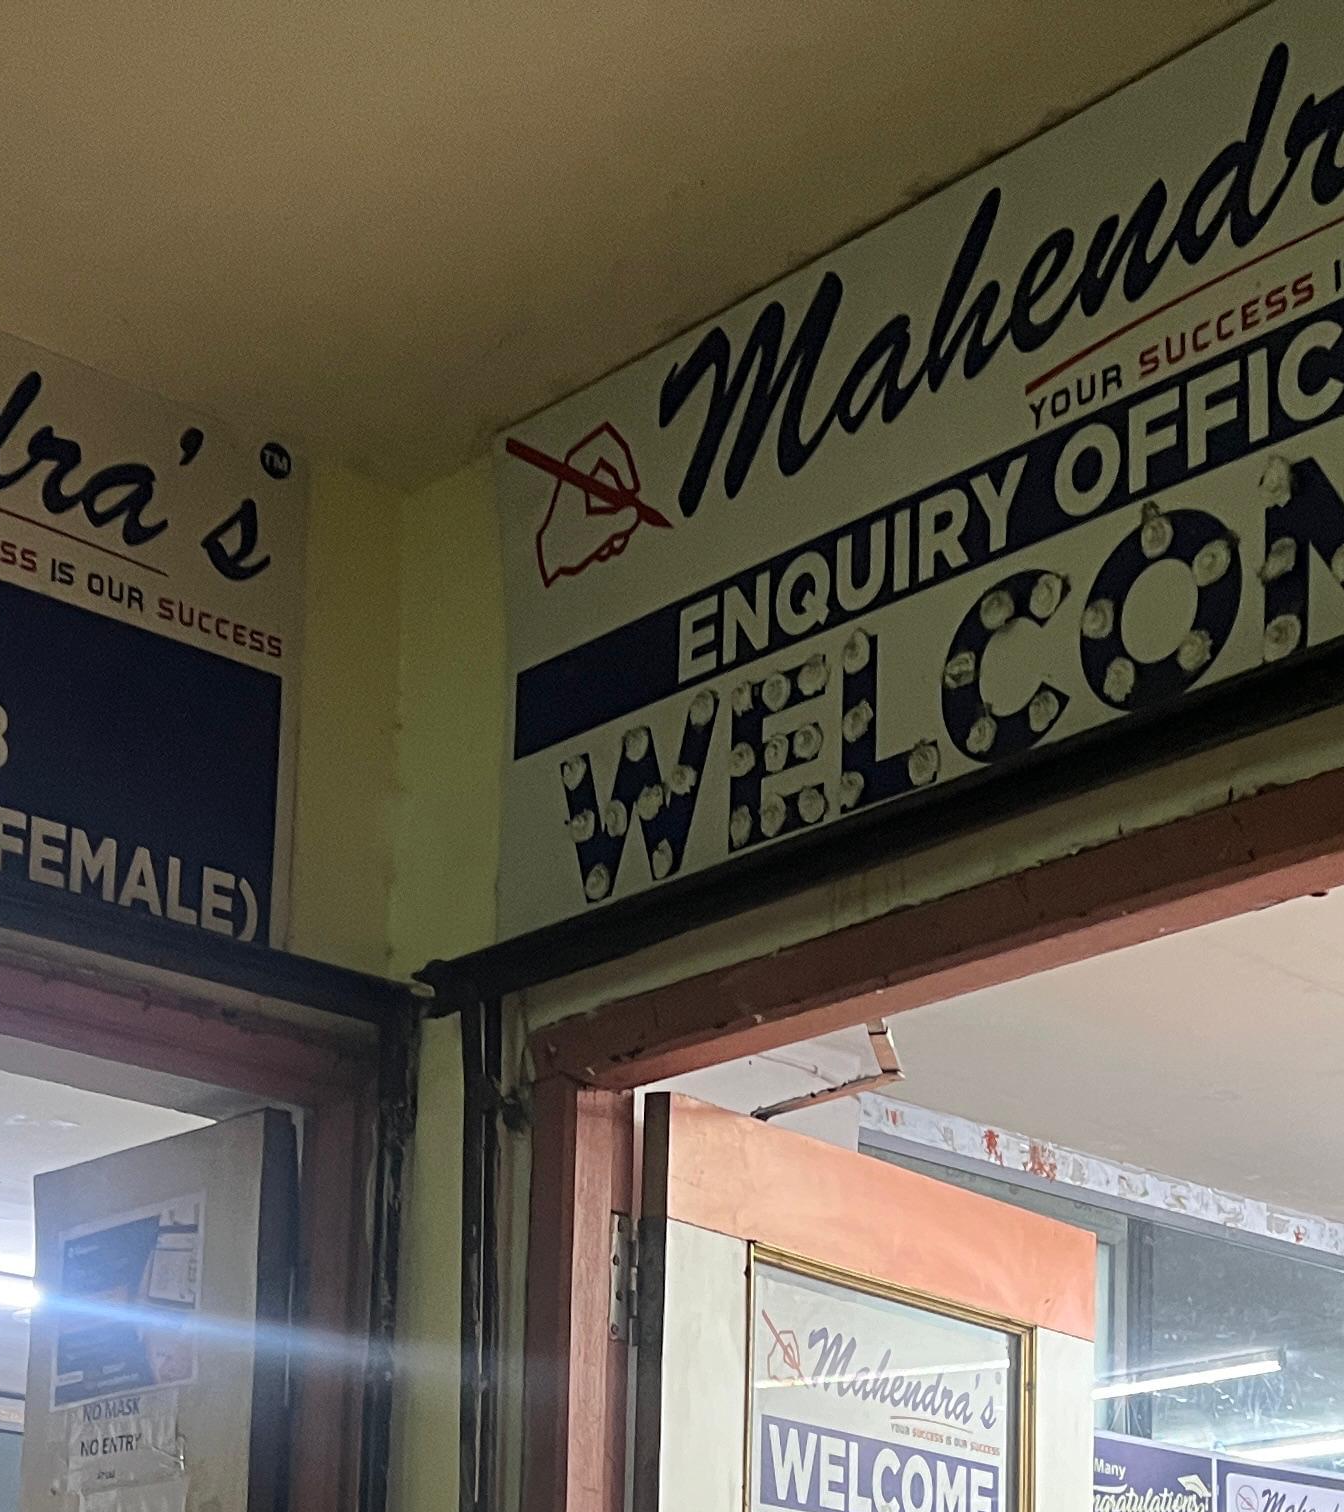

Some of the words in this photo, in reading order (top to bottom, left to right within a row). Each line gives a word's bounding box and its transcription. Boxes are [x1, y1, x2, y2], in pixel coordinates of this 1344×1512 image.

[1029, 365, 1122, 430] YOUR
[1139, 272, 1315, 379] SUCCESS
[51, 558, 75, 586] IS
[87, 575, 144, 611] OUR
[158, 598, 282, 658] SUCCESS
[678, 456, 1028, 684] ENQUIRY
[83, 1402, 102, 1424] NO
[809, 1327, 997, 1429] Mahendra's
[81, 1440, 99, 1456] NO
[1094, 1457, 1126, 1480] Many
